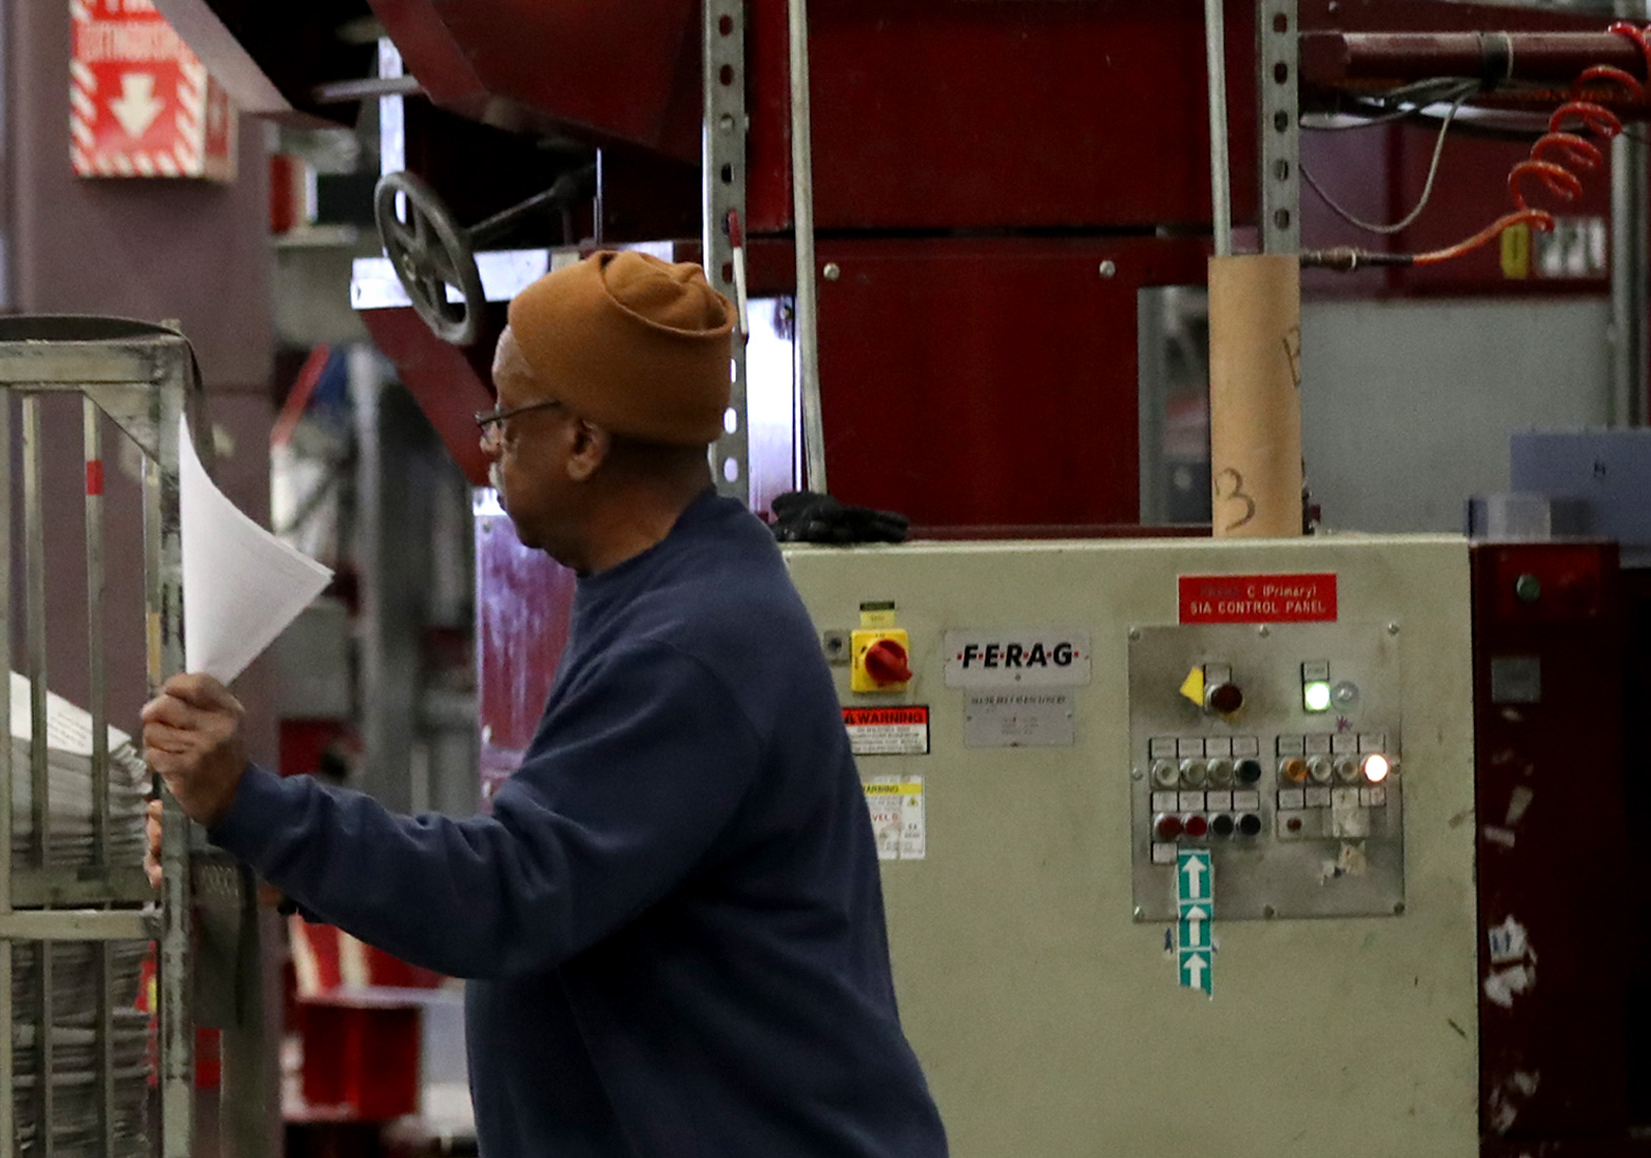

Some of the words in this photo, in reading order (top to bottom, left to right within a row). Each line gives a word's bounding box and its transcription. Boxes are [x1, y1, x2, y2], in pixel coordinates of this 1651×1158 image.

[1263, 584, 1317, 599] (Primary)
[1218, 600, 1278, 615] CONTROL
[1286, 600, 1326, 613] PANEL
[858, 712, 923, 724] WARNING
